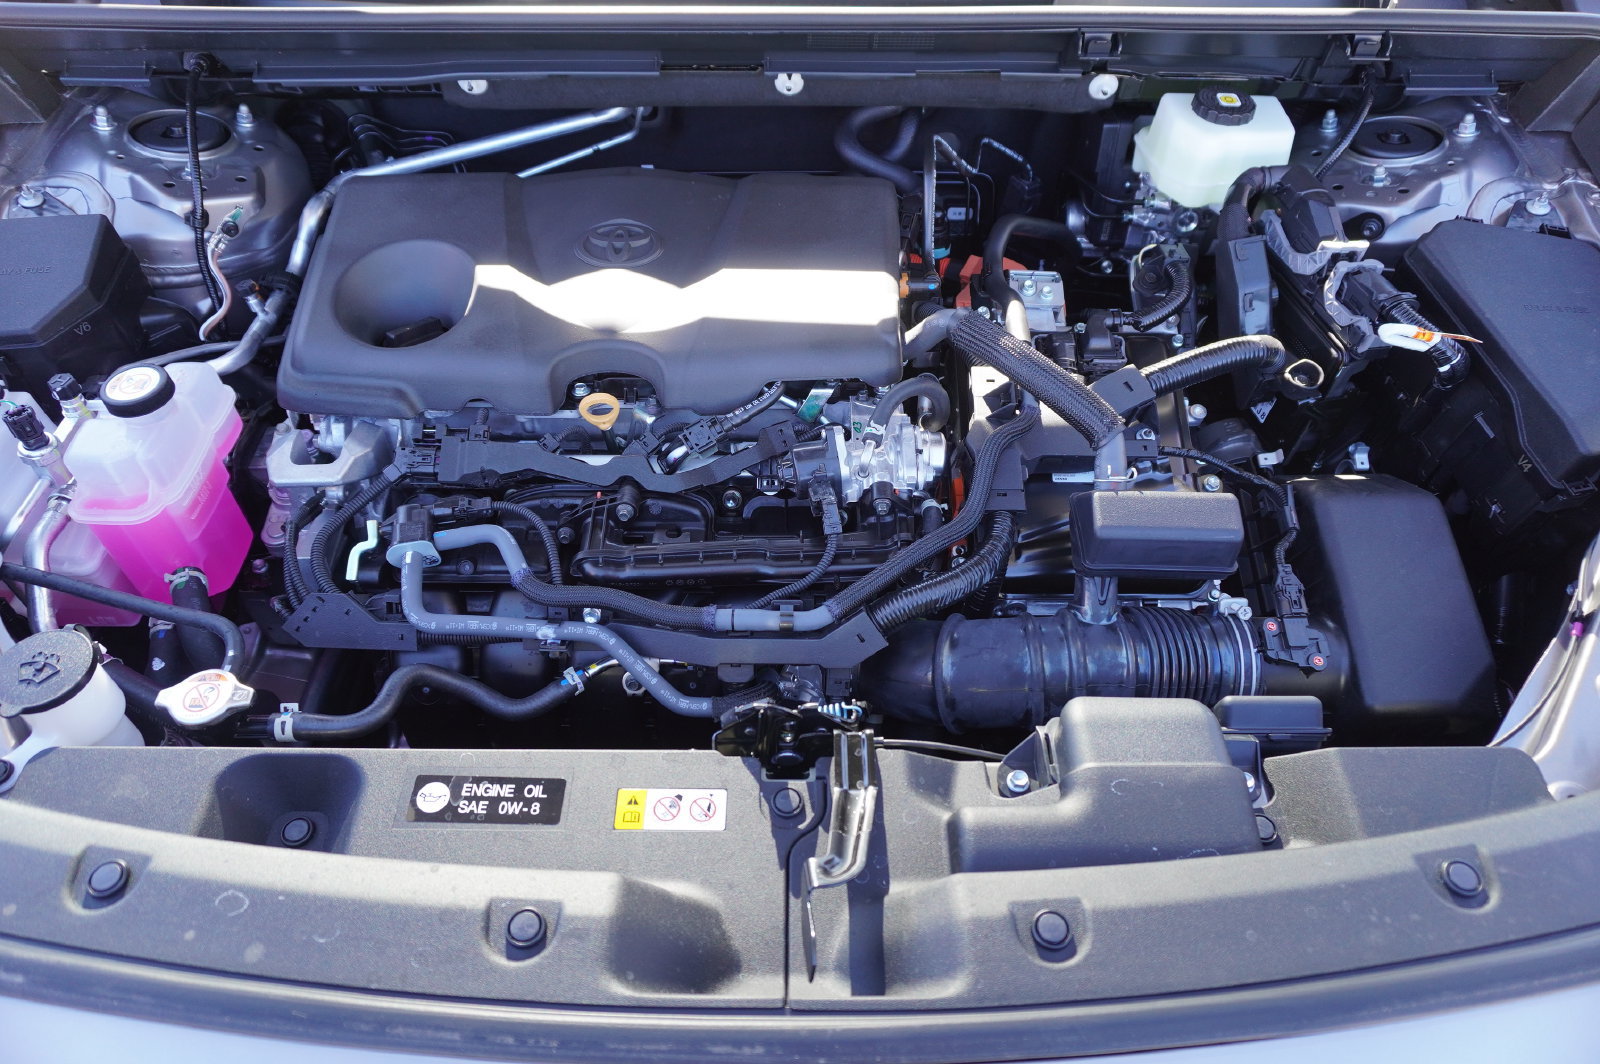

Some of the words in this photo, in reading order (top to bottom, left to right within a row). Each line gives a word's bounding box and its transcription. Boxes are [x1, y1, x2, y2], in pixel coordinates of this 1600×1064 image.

[73, 321, 92, 336] V6
[461, 783, 516, 798] ENGINE
[523, 784, 548, 798] OIL
[457, 800, 489, 814] SAE
